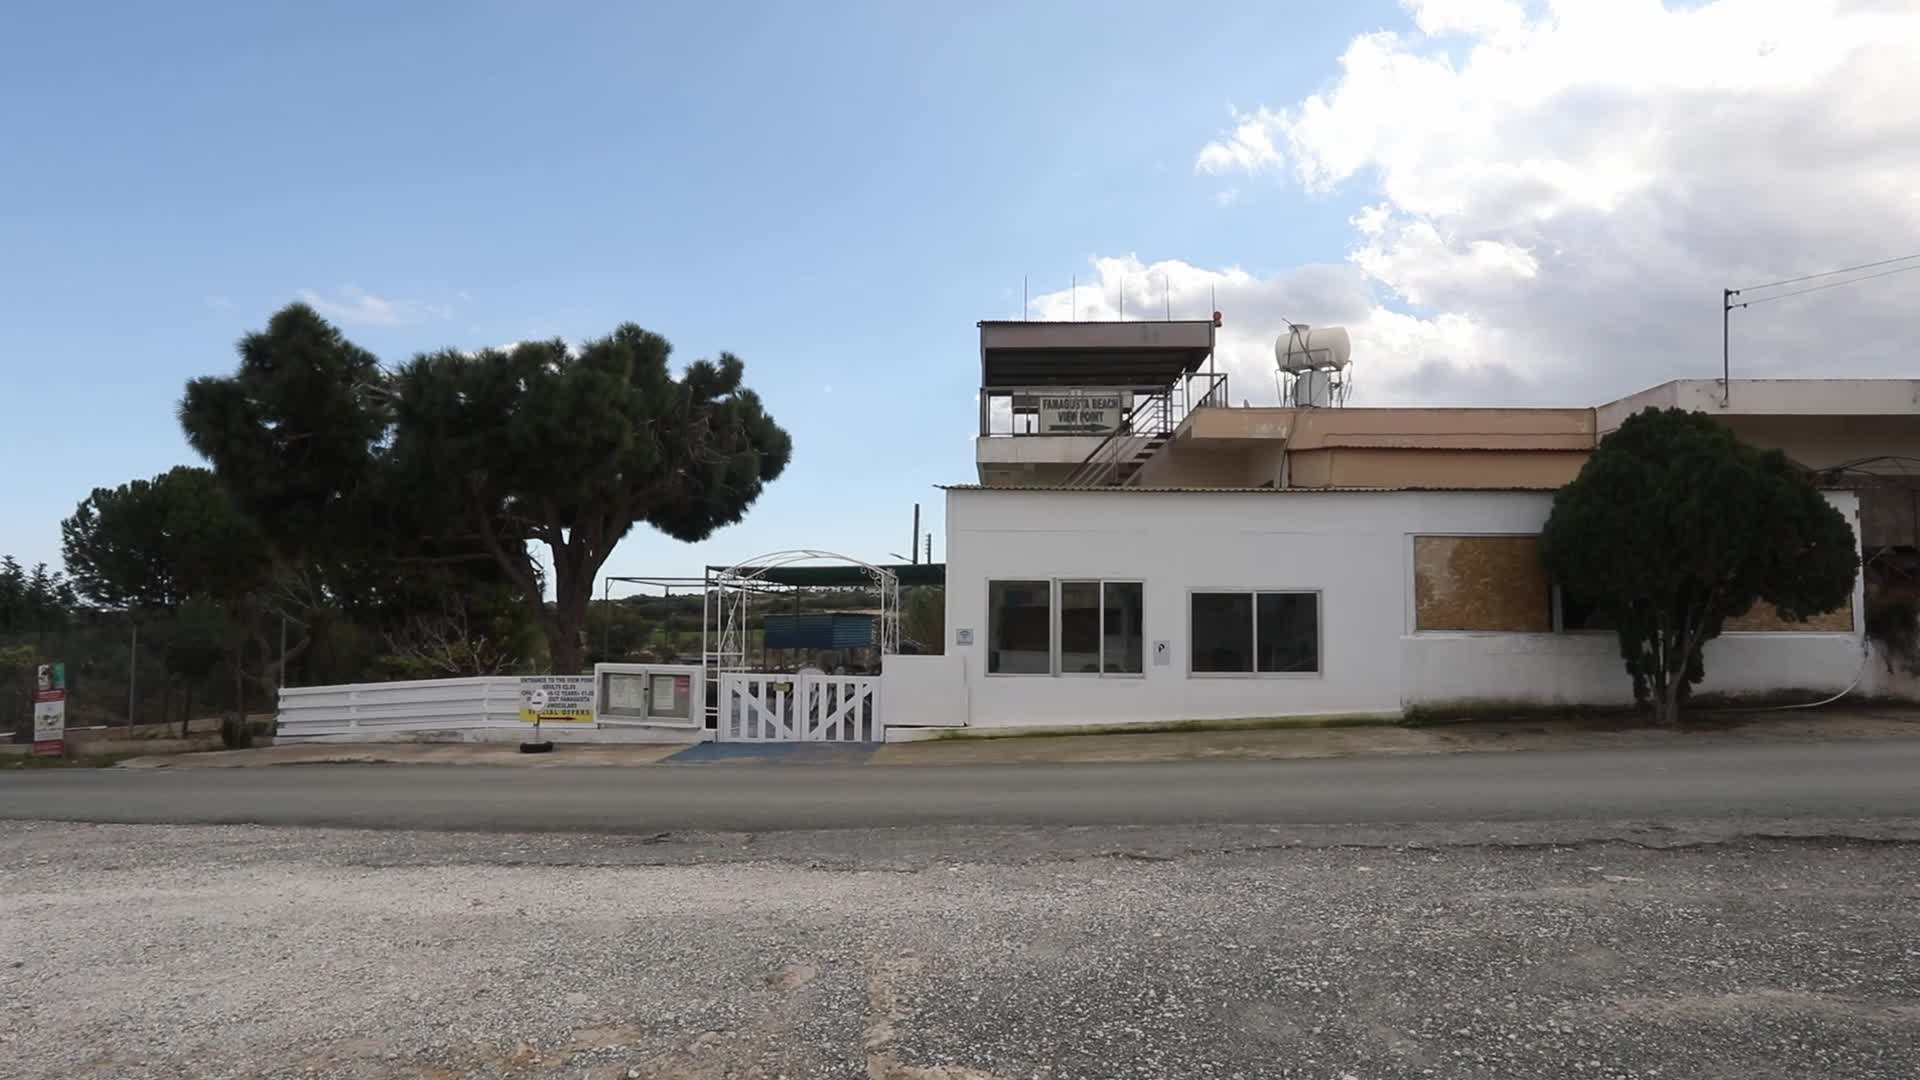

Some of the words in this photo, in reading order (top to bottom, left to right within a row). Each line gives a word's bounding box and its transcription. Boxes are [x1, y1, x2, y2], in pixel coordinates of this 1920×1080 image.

[1042, 398, 1090, 409] FAMAGUSTA
[1092, 398, 1118, 409] BEACH
[1057, 411, 1077, 423] VIEW
[1080, 411, 1104, 423] POINT
